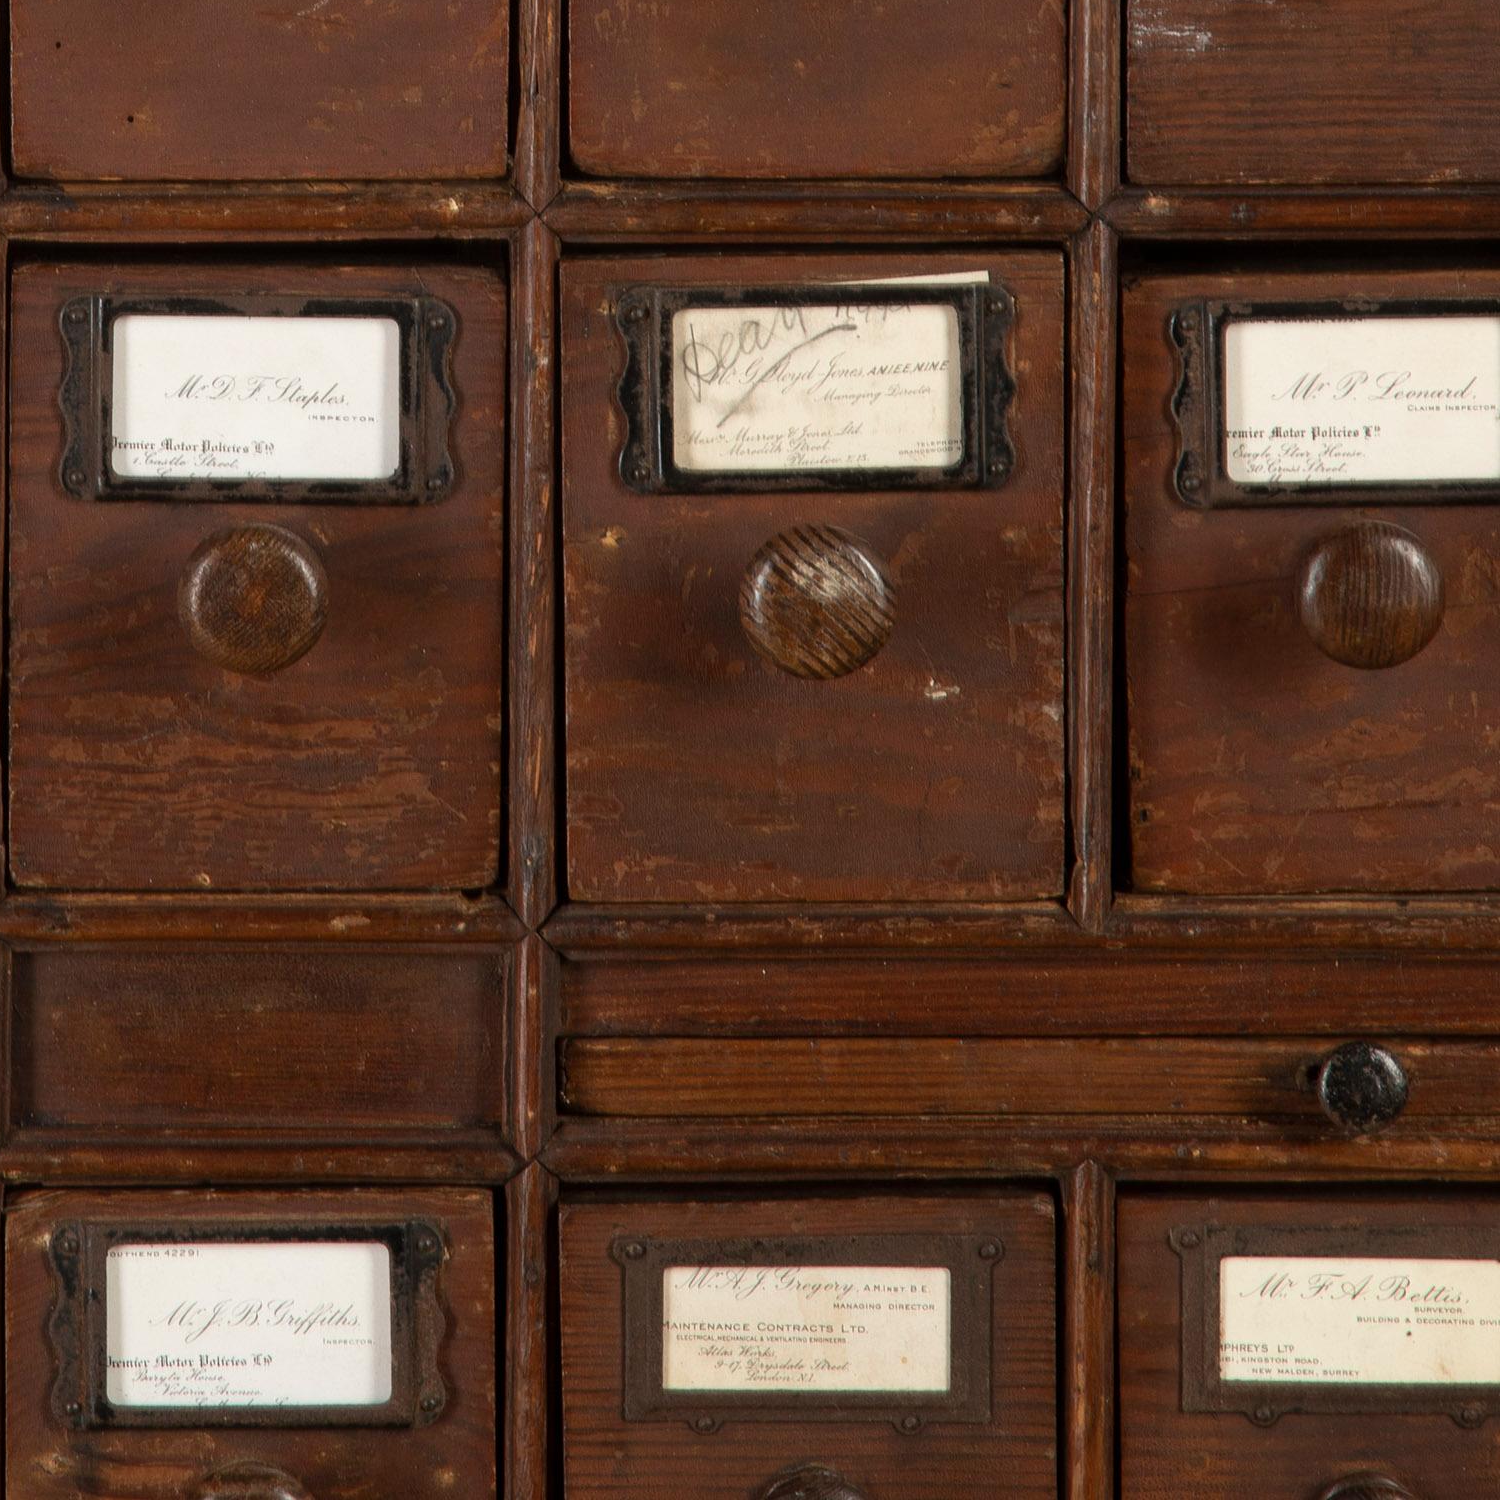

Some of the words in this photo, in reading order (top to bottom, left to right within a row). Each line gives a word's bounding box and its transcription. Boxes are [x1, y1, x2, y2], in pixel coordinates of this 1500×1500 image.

[1270, 427, 1305, 439] Motor
[1311, 426, 1359, 441] Policies
[160, 438, 198, 452] Motor
[201, 439, 249, 454] Policies
[1357, 1316, 1400, 1324] BUILDING
[662, 1322, 750, 1332] MAINTENANCE
[757, 1323, 834, 1333] CONTRACTS
[156, 1355, 194, 1368] Motor
[200, 1354, 247, 1368] Policies
[1241, 1357, 1288, 1365] KINGSTON
